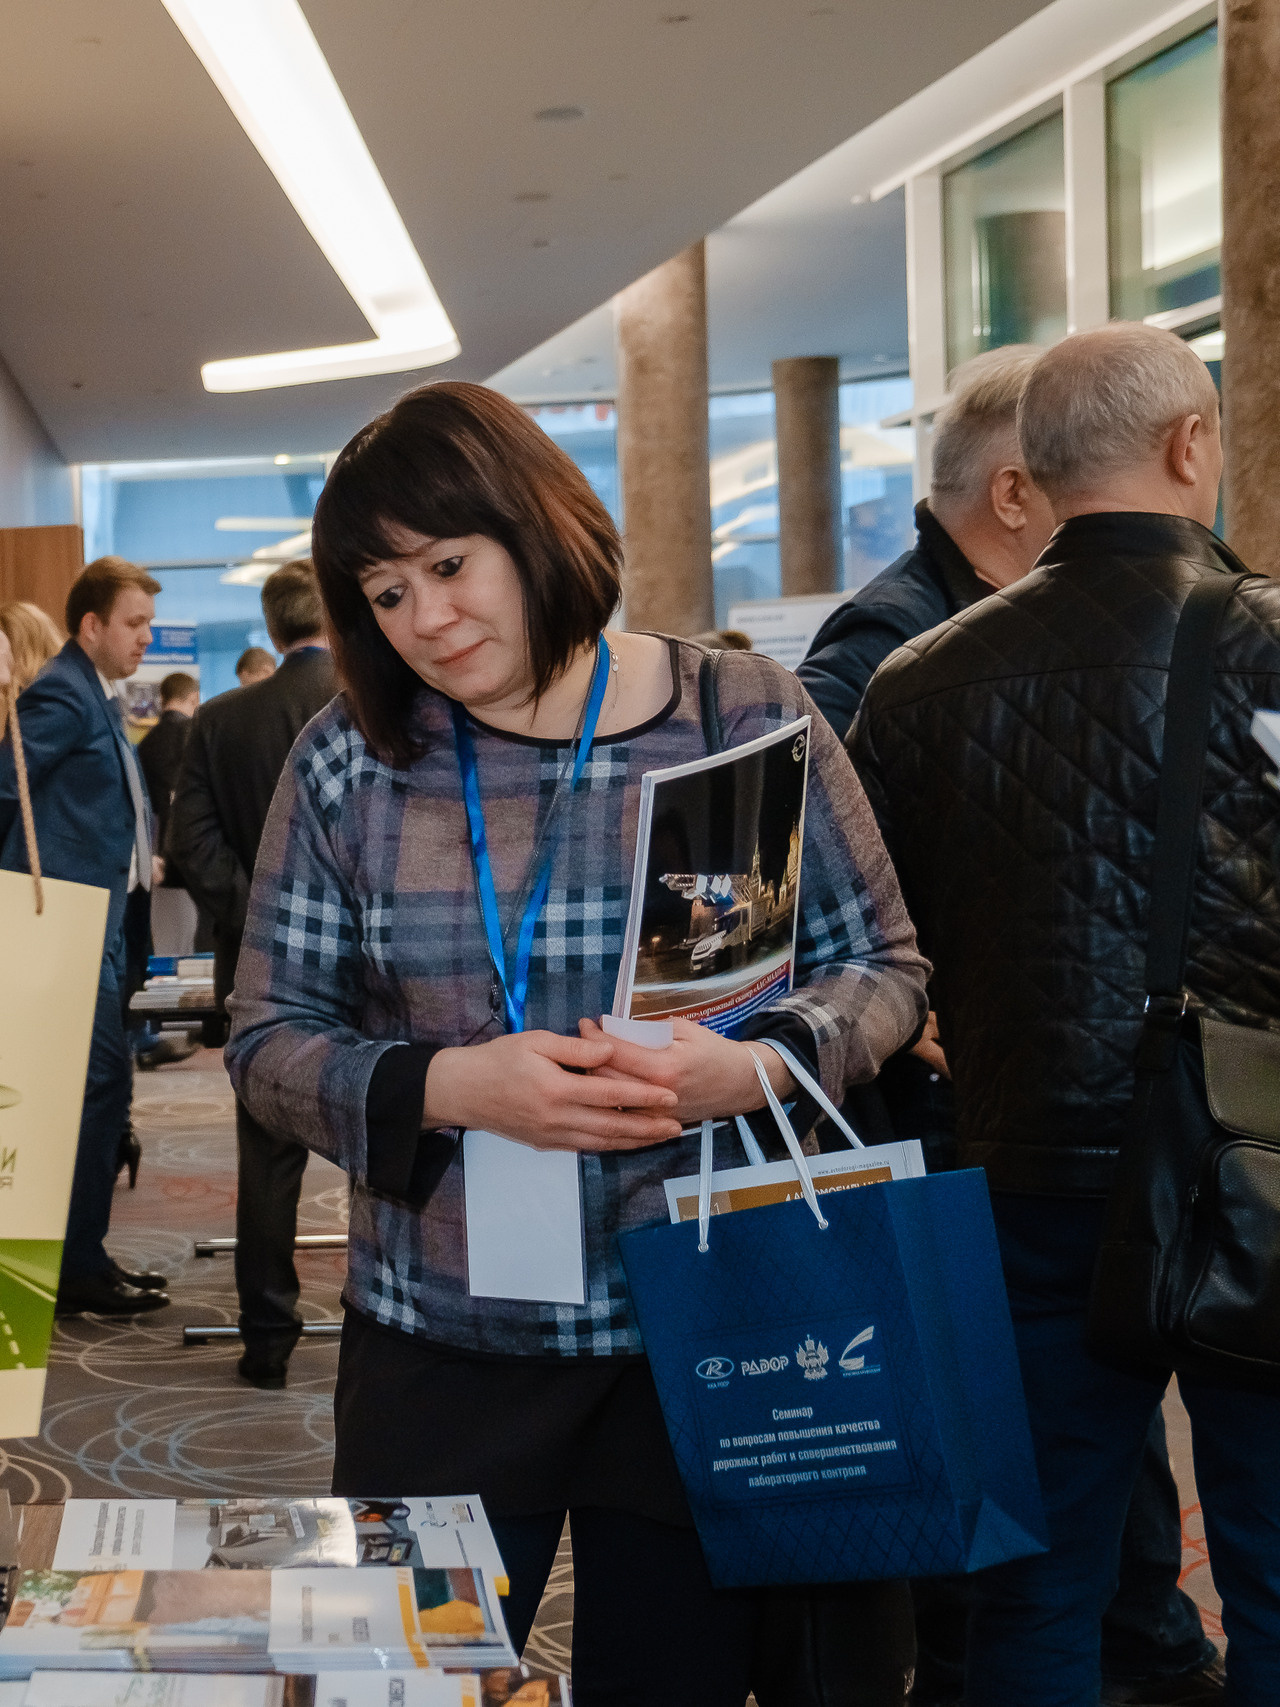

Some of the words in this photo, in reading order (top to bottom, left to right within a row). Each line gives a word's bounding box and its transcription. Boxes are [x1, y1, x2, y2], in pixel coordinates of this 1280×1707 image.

[772, 1407, 813, 1420] Семинар
[720, 1438, 731, 1448] по
[732, 1432, 776, 1447] вопросам
[778, 1425, 833, 1442] повышения
[835, 1420, 880, 1433] качества
[713, 1457, 759, 1471] дорожных
[761, 1451, 787, 1466] работ
[790, 1452, 796, 1461] и
[798, 1440, 897, 1460] совершенствования
[748, 1470, 819, 1488] лабораторного
[821, 1464, 867, 1480] контроля
